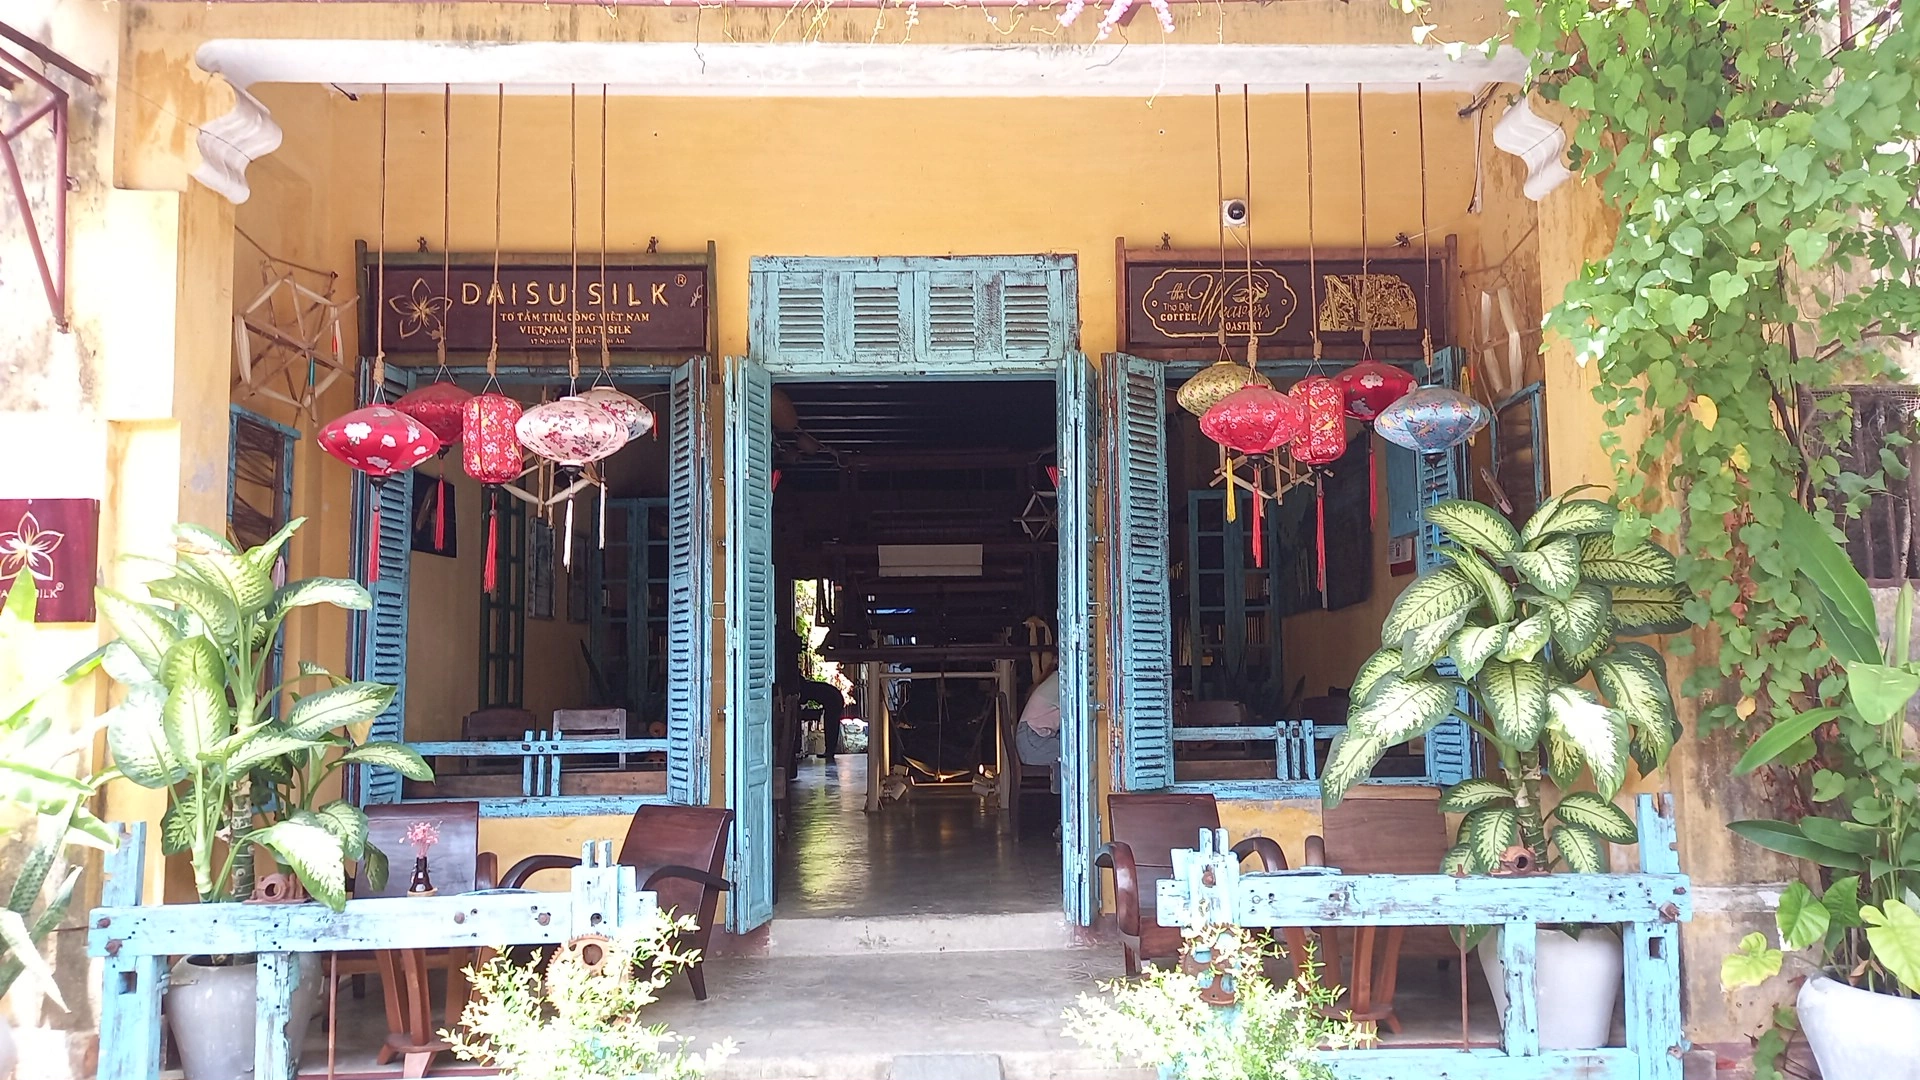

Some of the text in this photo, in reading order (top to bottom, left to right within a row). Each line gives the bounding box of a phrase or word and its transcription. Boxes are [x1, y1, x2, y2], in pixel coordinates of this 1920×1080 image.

[461, 281, 567, 306] DAISU
[588, 282, 669, 307] SILK
[626, 312, 650, 322] NAM
[1160, 313, 1198, 322] COFFEE
[519, 325, 567, 335] VIETNAM
[607, 325, 632, 335] SILK
